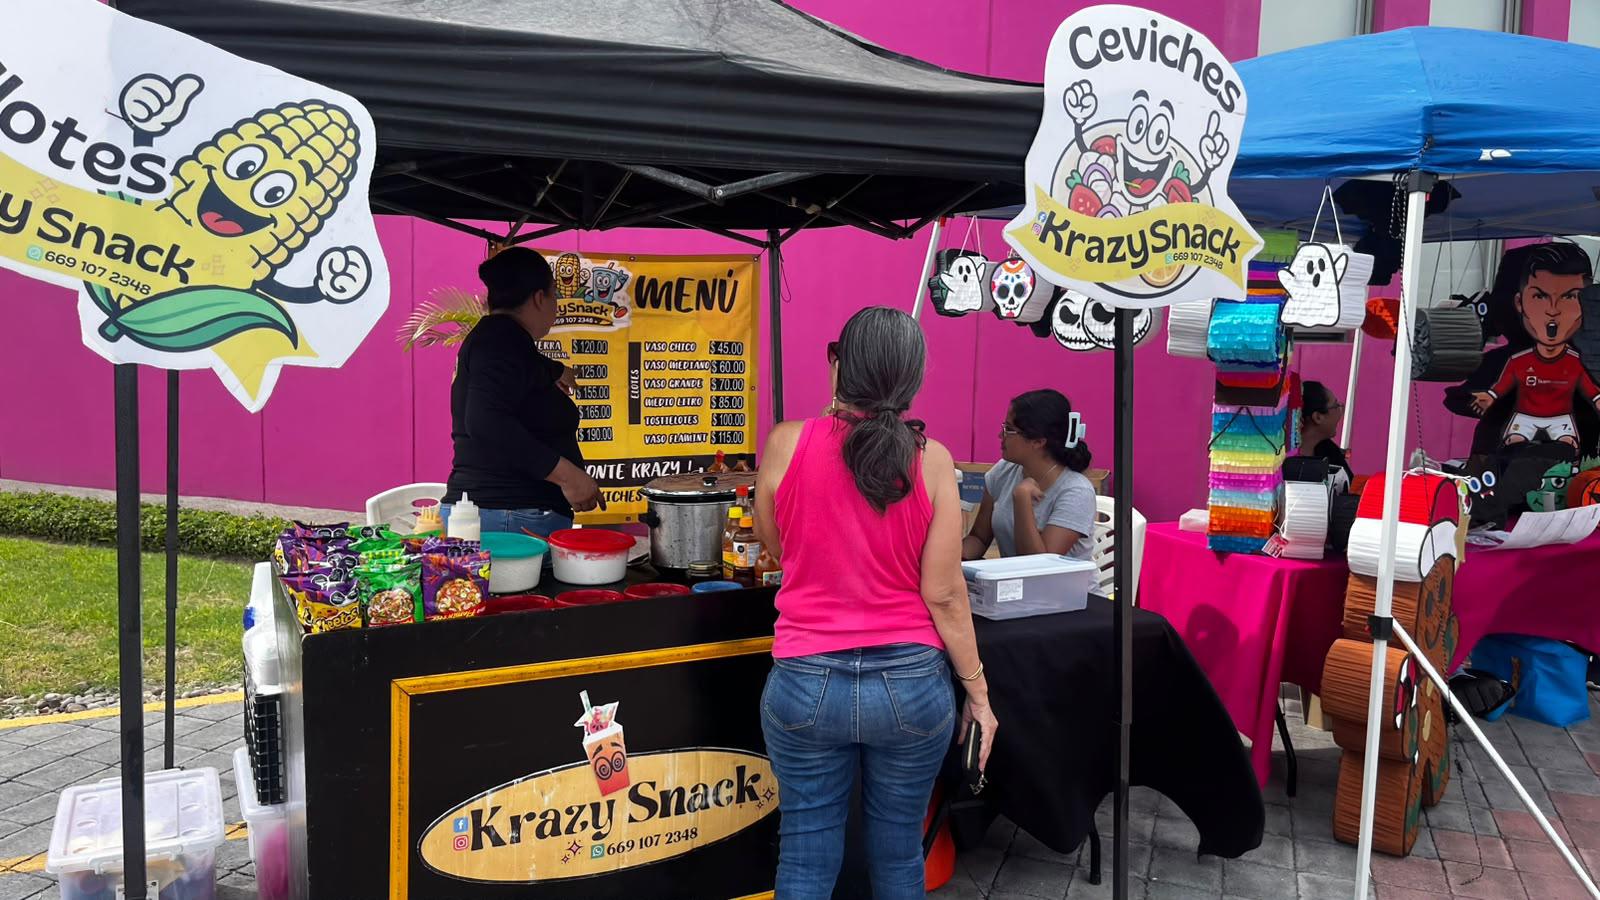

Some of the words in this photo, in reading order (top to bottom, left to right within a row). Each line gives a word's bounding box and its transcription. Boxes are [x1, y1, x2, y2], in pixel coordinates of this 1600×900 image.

[1069, 19, 1241, 113] Ceviches
[0, 62, 167, 194] otes
[1173, 252, 1188, 261] 669
[1190, 252, 1203, 261] 107
[1204, 255, 1223, 269] 2348
[45, 251, 77, 268] 669
[82, 261, 107, 277] 107
[109, 272, 151, 296] 2348
[634, 269, 739, 313] MENÚ
[644, 342, 667, 352] VASO
[669, 342, 696, 352] CHICO
[644, 361, 666, 371] VASO
[669, 361, 710, 371] MEDIANO
[630, 369, 639, 399] ELOTES
[644, 379, 666, 389] VASO
[669, 379, 703, 388] GRANDE
[644, 398, 674, 408] MEDIO
[644, 434, 666, 444] VASO
[585, 463, 625, 479] ONTE
[632, 461, 680, 477] KRAZY
[471, 799, 616, 851] Krazy
[628, 765, 763, 823] Snack
[607, 840, 625, 855] 669
[639, 834, 661, 849] 107
[665, 827, 698, 844] 2348
